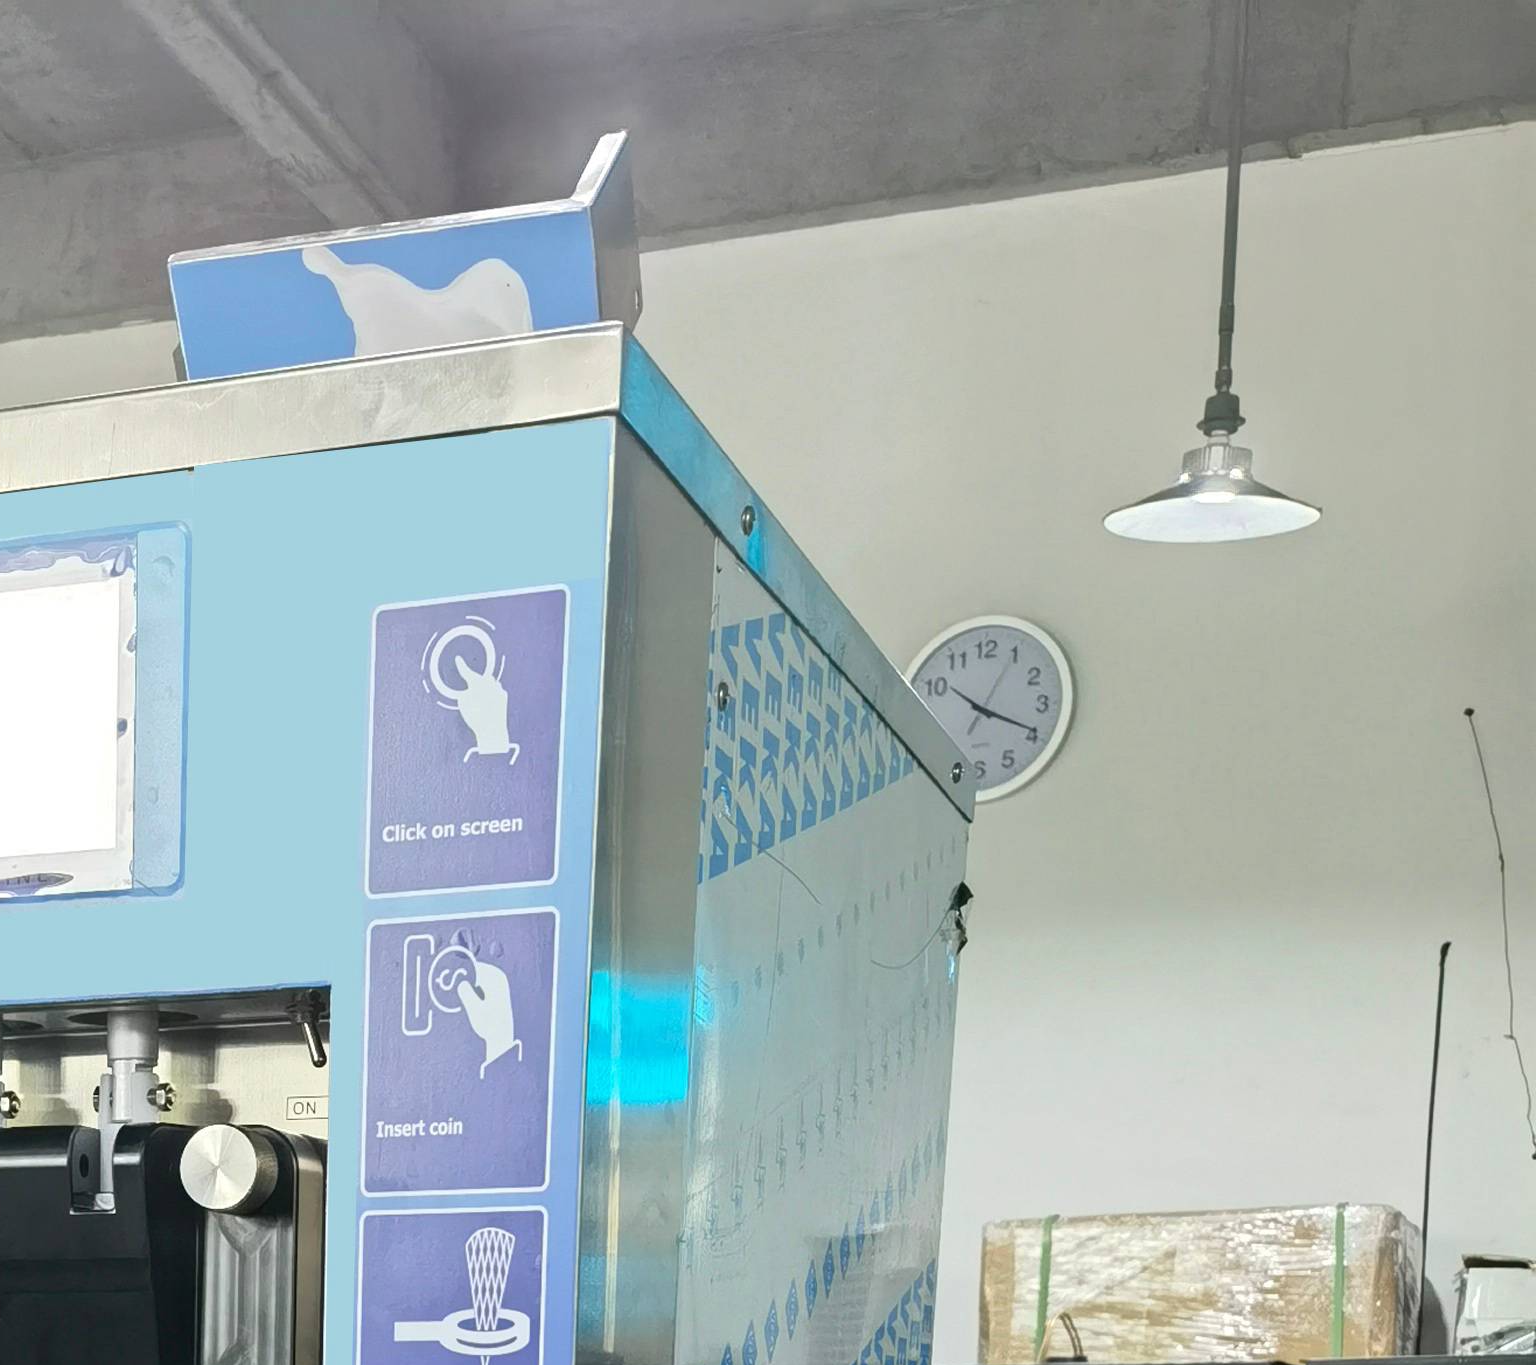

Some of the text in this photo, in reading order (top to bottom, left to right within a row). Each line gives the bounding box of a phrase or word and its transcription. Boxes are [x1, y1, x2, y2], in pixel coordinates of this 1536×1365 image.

[975, 640, 998, 659] 12
[1011, 646, 1019, 664] 1
[948, 651, 967, 670] 11
[1027, 667, 1041, 686] 2
[925, 677, 948, 696] 10
[1035, 694, 1049, 714] 3
[734, 617, 764, 867] VEKA
[758, 612, 785, 855] VEKA
[1001, 750, 1014, 768] 5
[382, 817, 523, 843] Click on screen
[293, 1101, 316, 1115] ON
[376, 1117, 463, 1138] Insert coin
